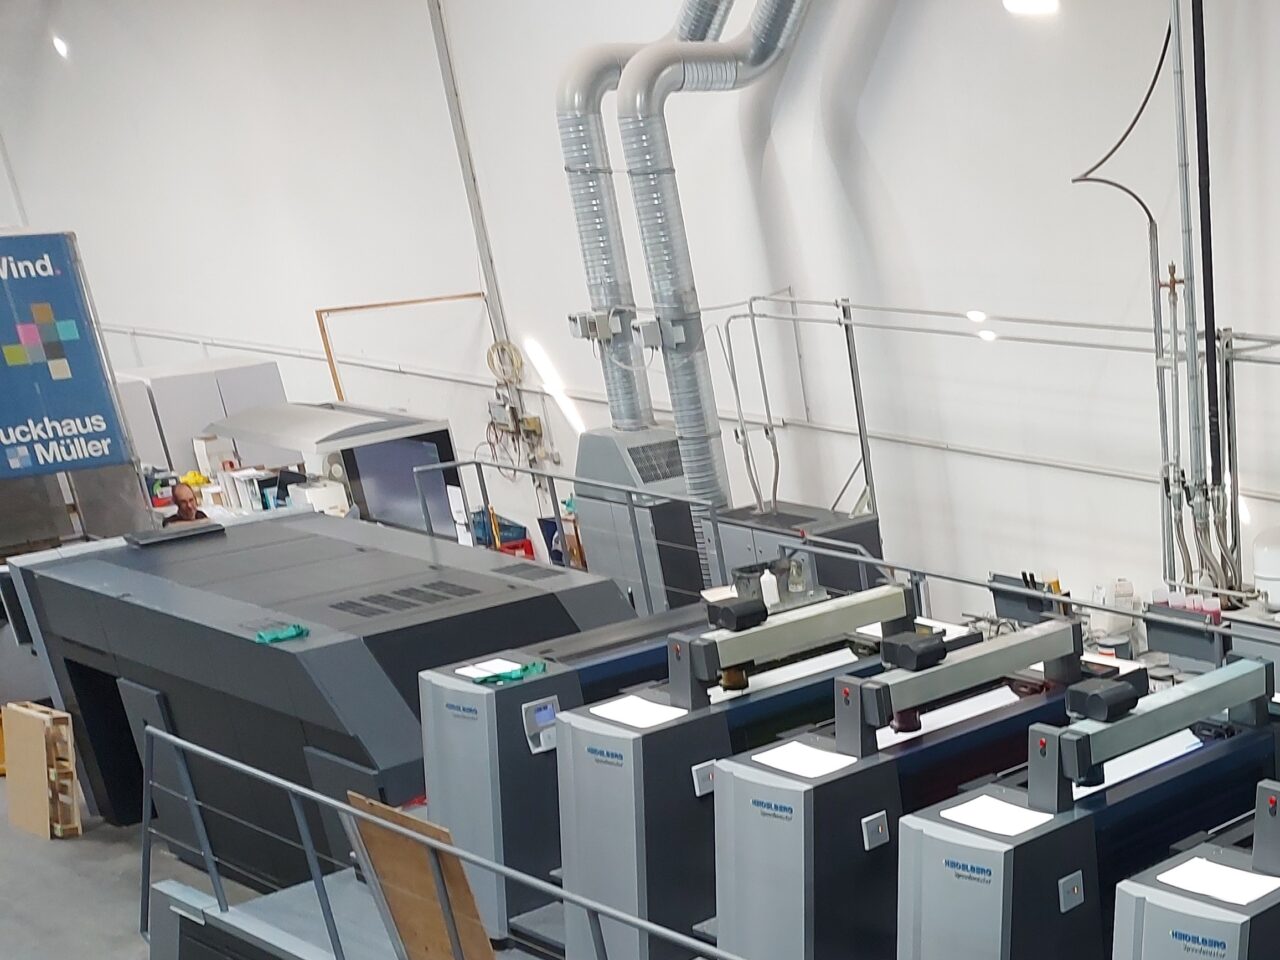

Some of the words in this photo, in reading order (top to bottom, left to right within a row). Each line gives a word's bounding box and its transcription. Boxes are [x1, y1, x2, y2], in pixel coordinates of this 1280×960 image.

[33, 437, 112, 465] Müller
[944, 859, 992, 877] HEIDELBERG
[1171, 929, 1227, 950] HEIDELBERG
